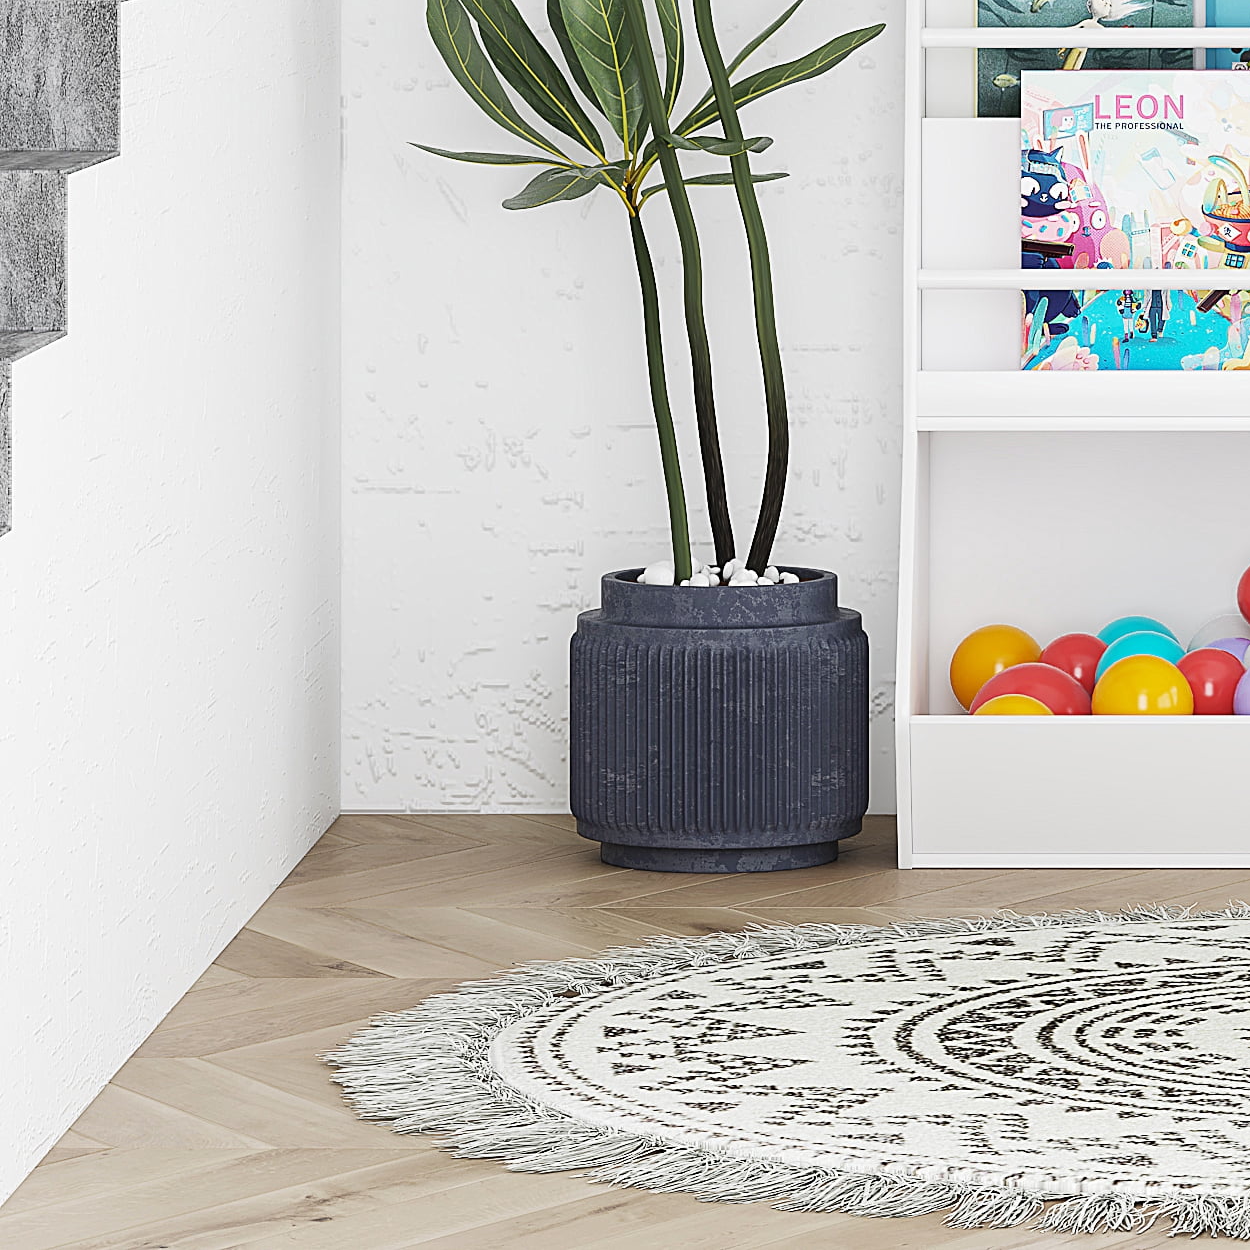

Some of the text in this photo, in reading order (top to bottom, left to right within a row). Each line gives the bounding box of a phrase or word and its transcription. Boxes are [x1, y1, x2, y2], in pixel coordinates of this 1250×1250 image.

[1094, 94, 1184, 120] LEON
[1095, 122, 1184, 130] THE PROFESSIONAL
